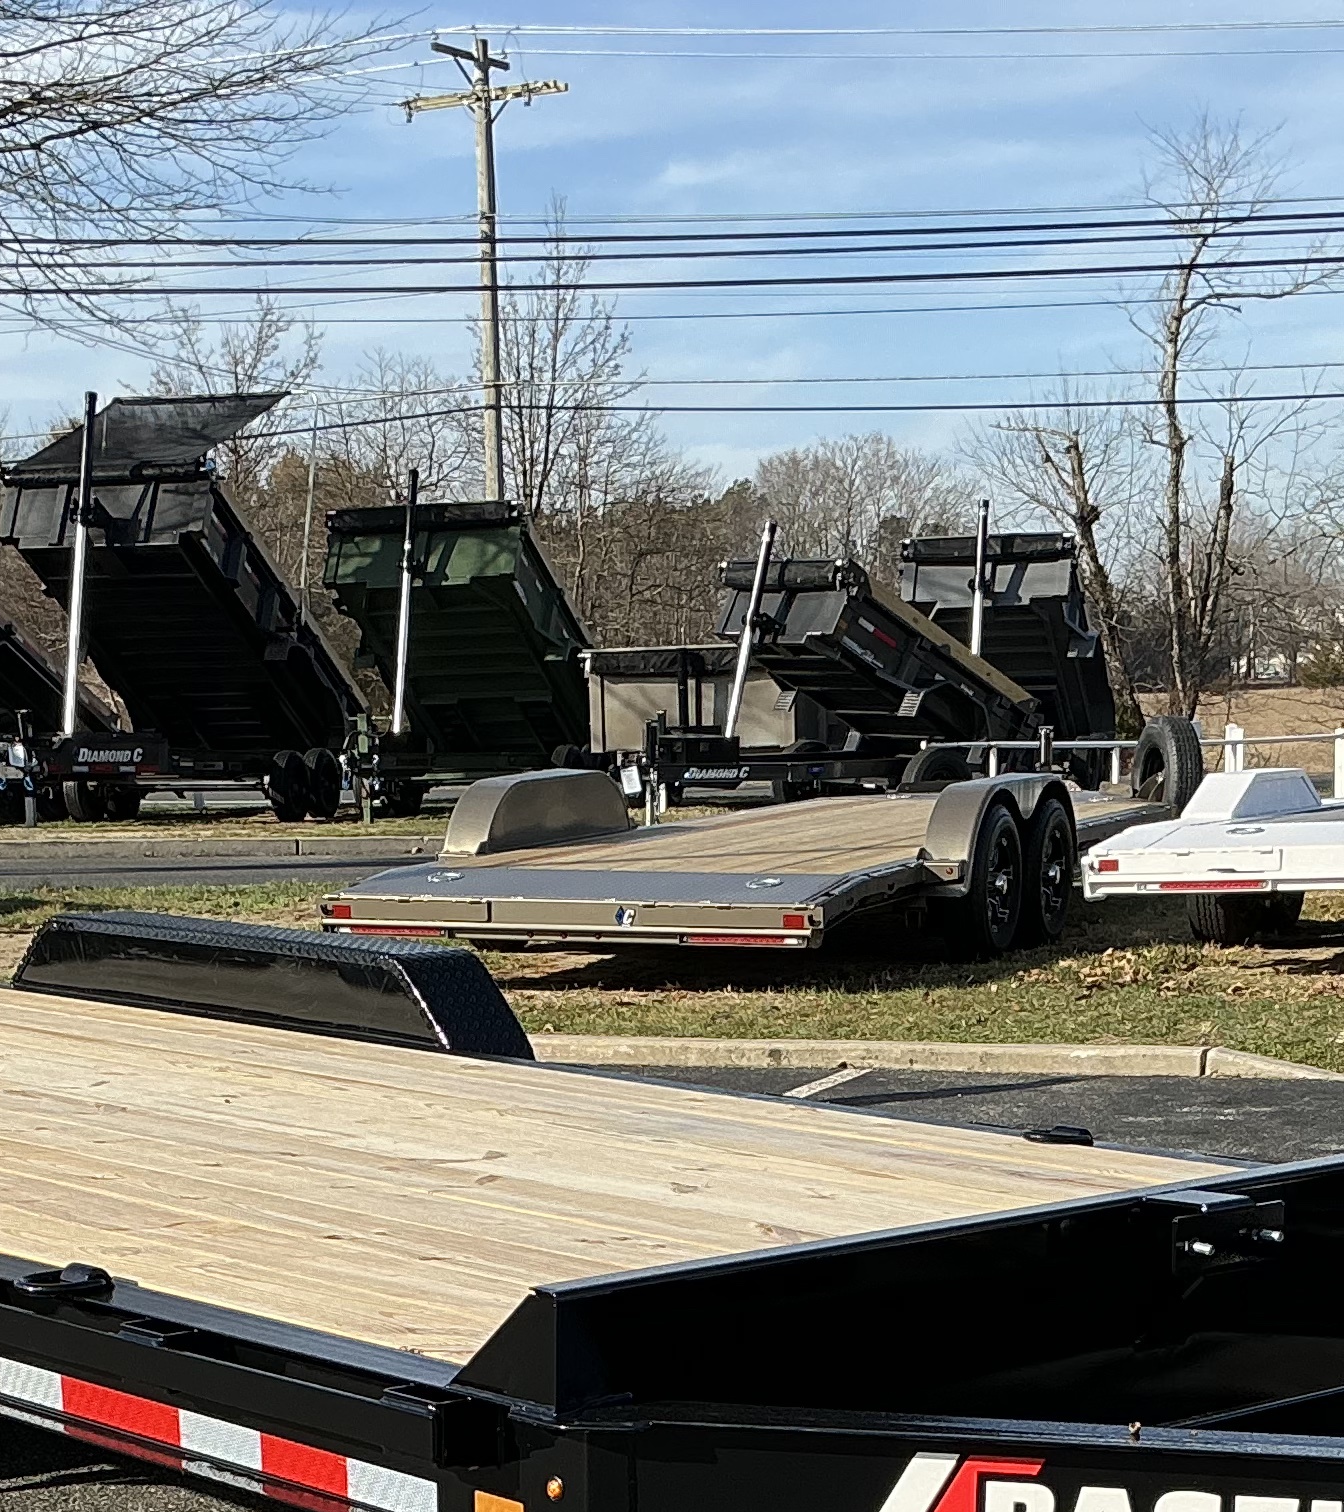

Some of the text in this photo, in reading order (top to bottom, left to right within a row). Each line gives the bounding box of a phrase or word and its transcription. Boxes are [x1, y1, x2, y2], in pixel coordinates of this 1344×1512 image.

[78, 748, 143, 762] DIAMOND C
[688, 766, 750, 779] DIAMOND C
